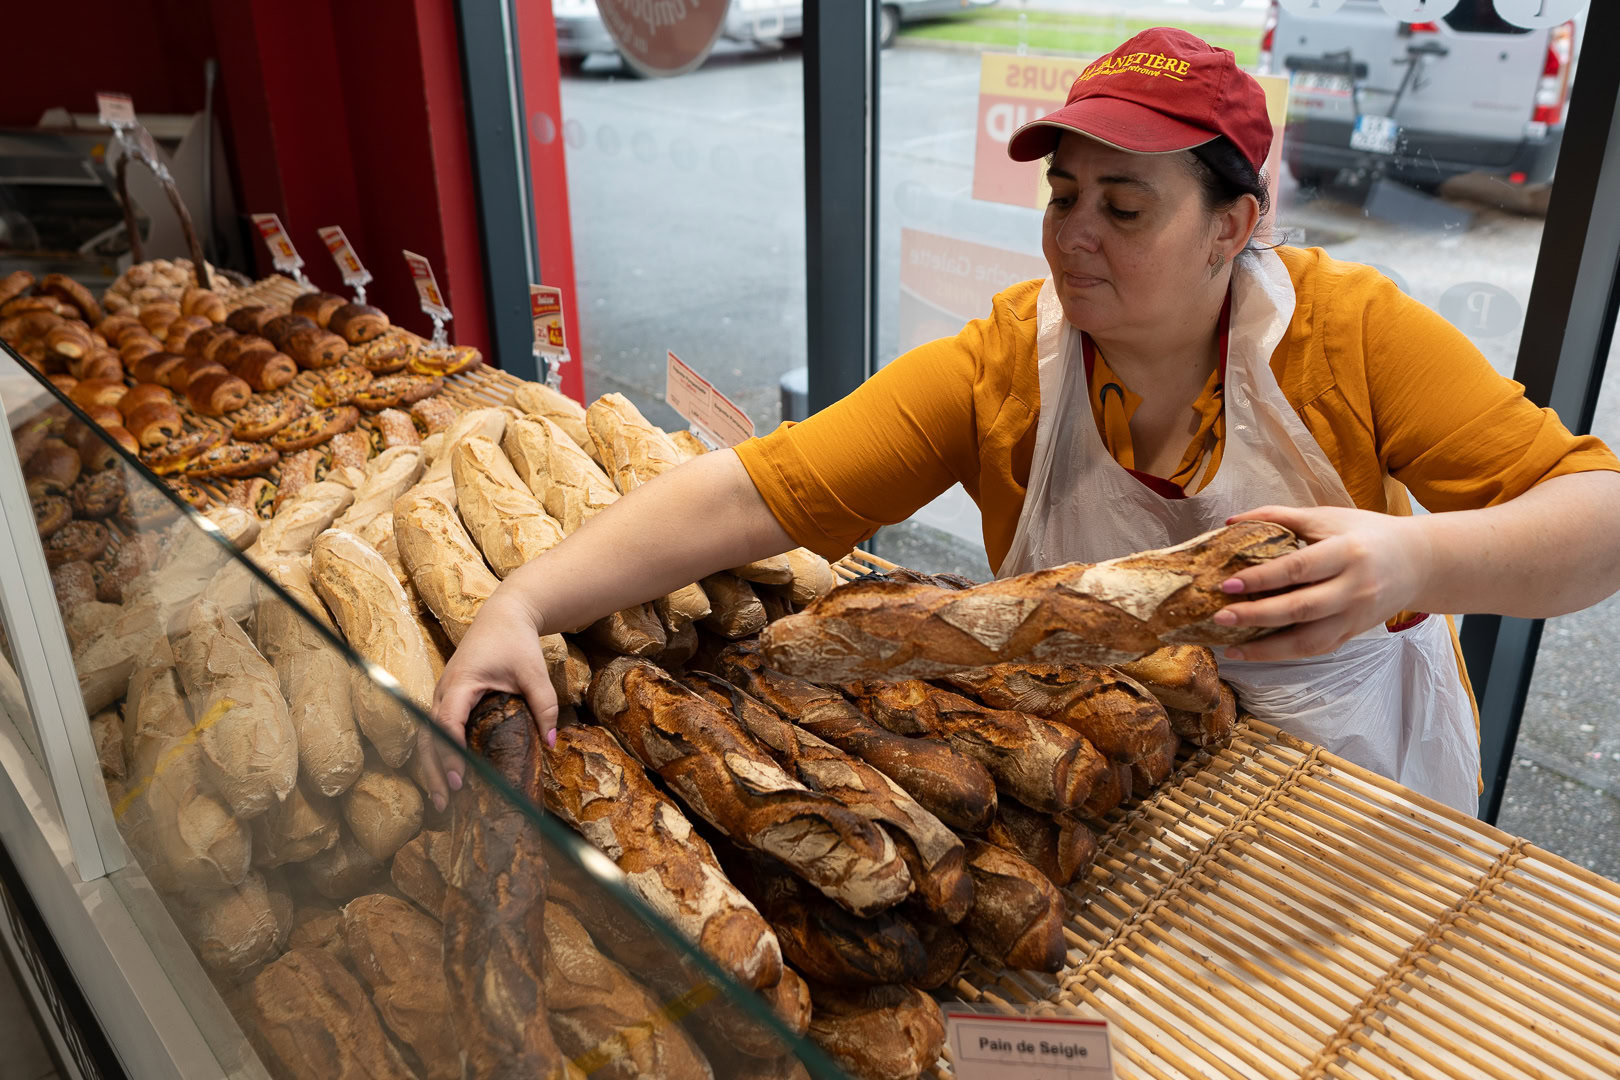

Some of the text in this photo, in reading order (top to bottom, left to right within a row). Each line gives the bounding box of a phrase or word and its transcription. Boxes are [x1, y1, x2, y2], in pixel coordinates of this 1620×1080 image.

[978, 1037, 1088, 1060] Pain de Seigle
